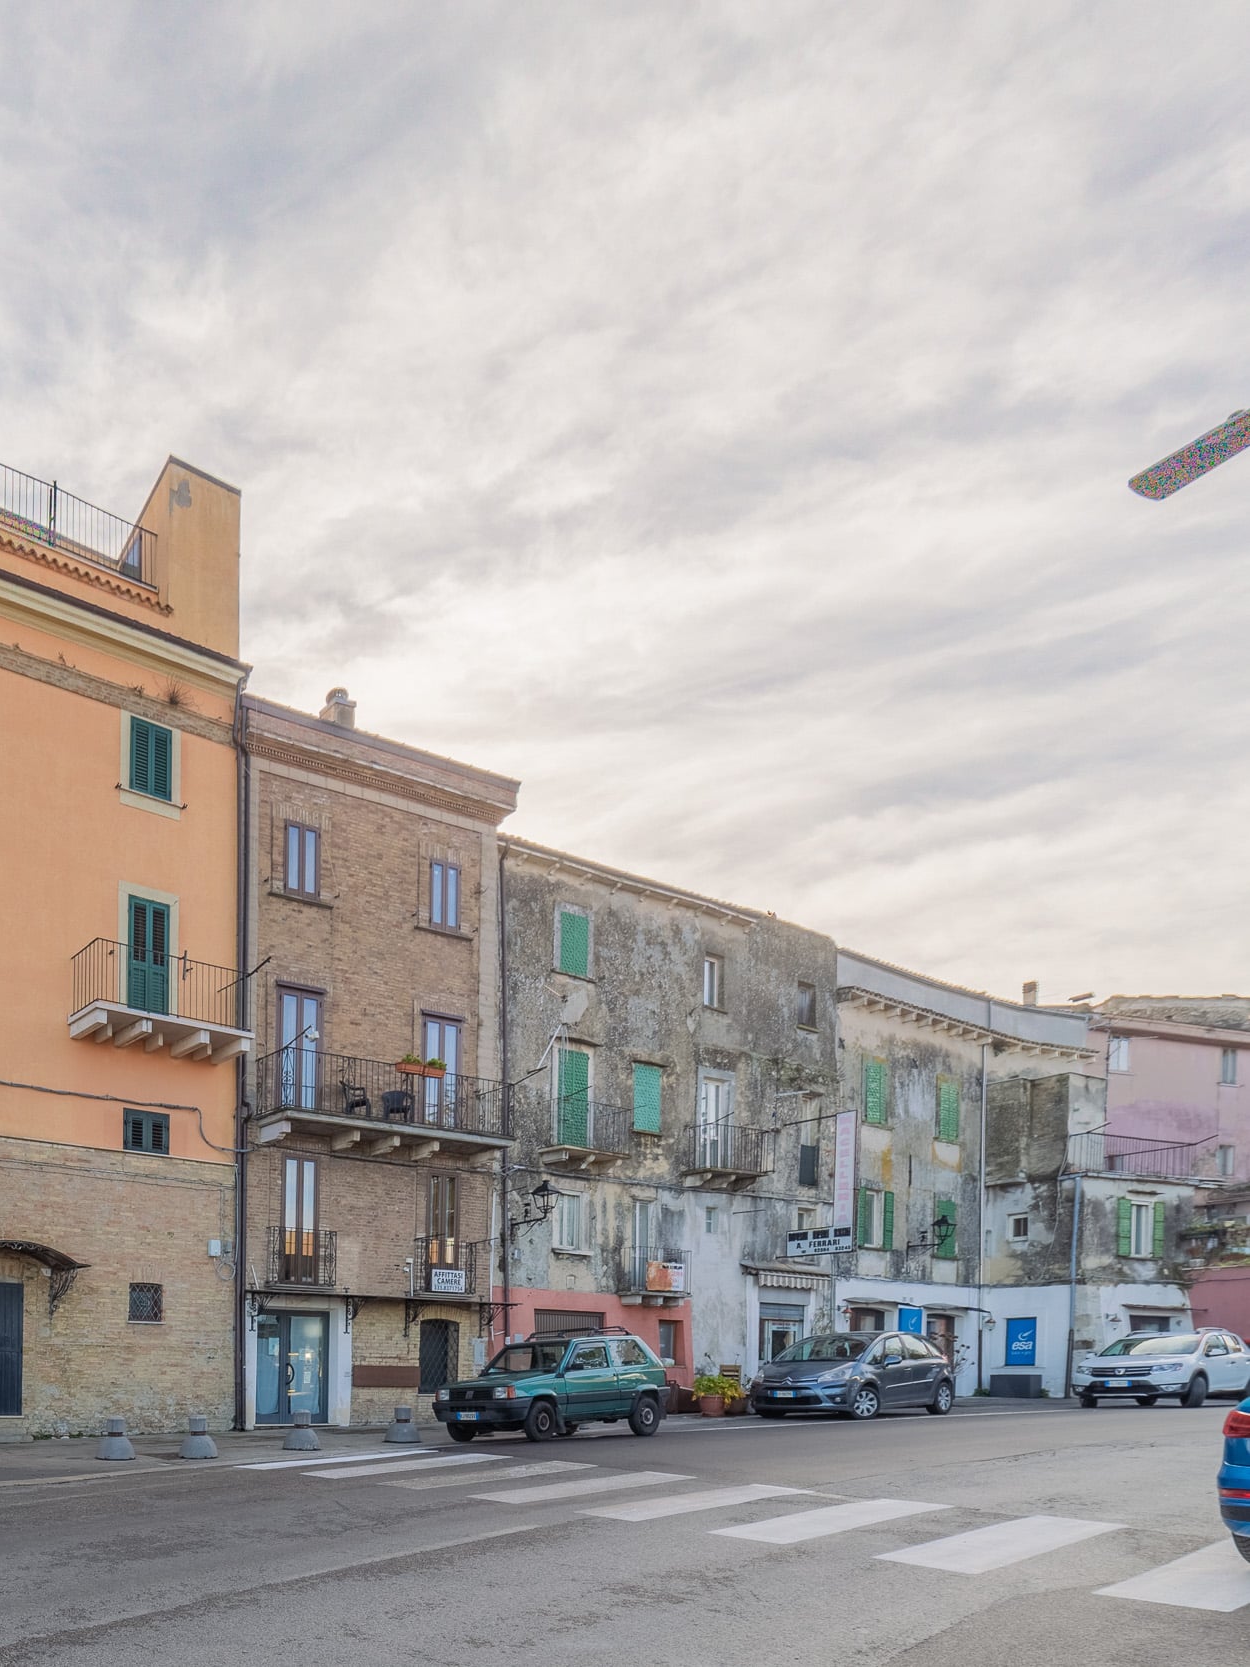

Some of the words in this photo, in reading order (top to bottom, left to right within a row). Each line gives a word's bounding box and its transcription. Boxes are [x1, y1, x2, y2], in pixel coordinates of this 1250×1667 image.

[809, 1239, 841, 1248] FERRARI
[434, 1271, 464, 1279] AFFITTASI
[437, 1277, 461, 1286] CAMERE
[1012, 1341, 1033, 1351] esa
